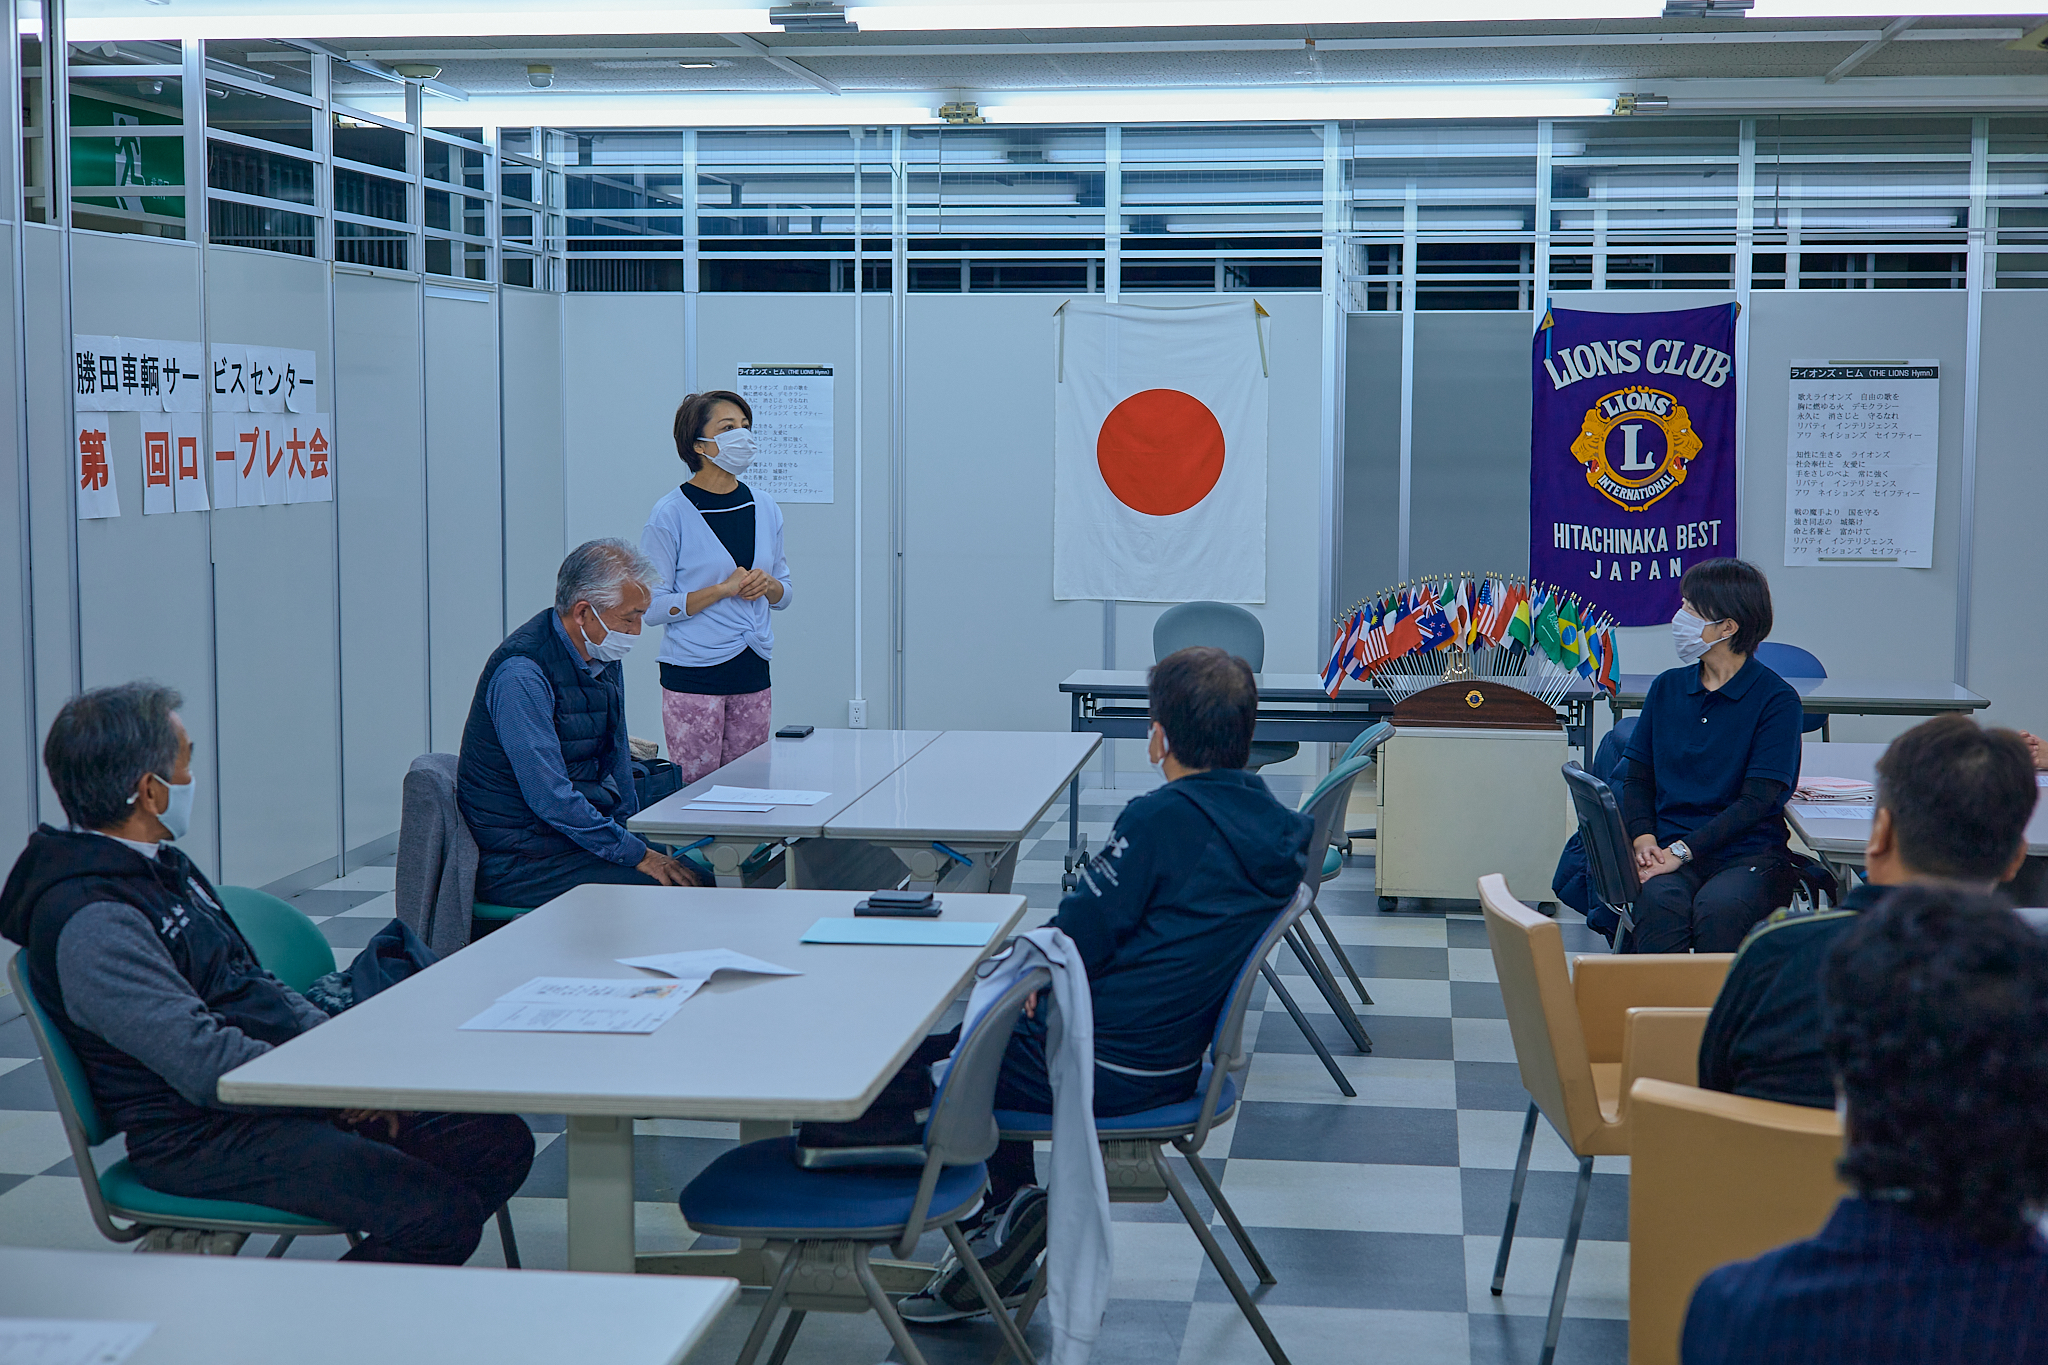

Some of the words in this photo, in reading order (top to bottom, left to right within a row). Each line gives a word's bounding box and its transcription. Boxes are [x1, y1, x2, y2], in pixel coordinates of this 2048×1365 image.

[1543, 338, 1642, 391] LIONS
[1645, 338, 1732, 389] CLUB
[1791, 368, 1864, 378] ライオンズ・ヒム
[1888, 369, 1909, 377] LIONS
[1601, 391, 1672, 418] LIONS
[1820, 431, 1867, 440] ネイションズ
[1619, 424, 1656, 471] L
[1851, 451, 1890, 459] ライオンズ
[78, 428, 109, 491] 第
[144, 426, 329, 488] 回ロープレ大会
[1597, 473, 1675, 502] INTERNATIONAL
[1834, 479, 1897, 488] インテリジェンス
[1818, 489, 1865, 497] ネイションズ
[1553, 522, 1669, 555] HITACHINAKA
[1676, 519, 1722, 551] BEST
[1831, 537, 1894, 545] インテリジェンス
[1815, 547, 1863, 555] ネイションズ
[1589, 557, 1683, 582] JAPAN
